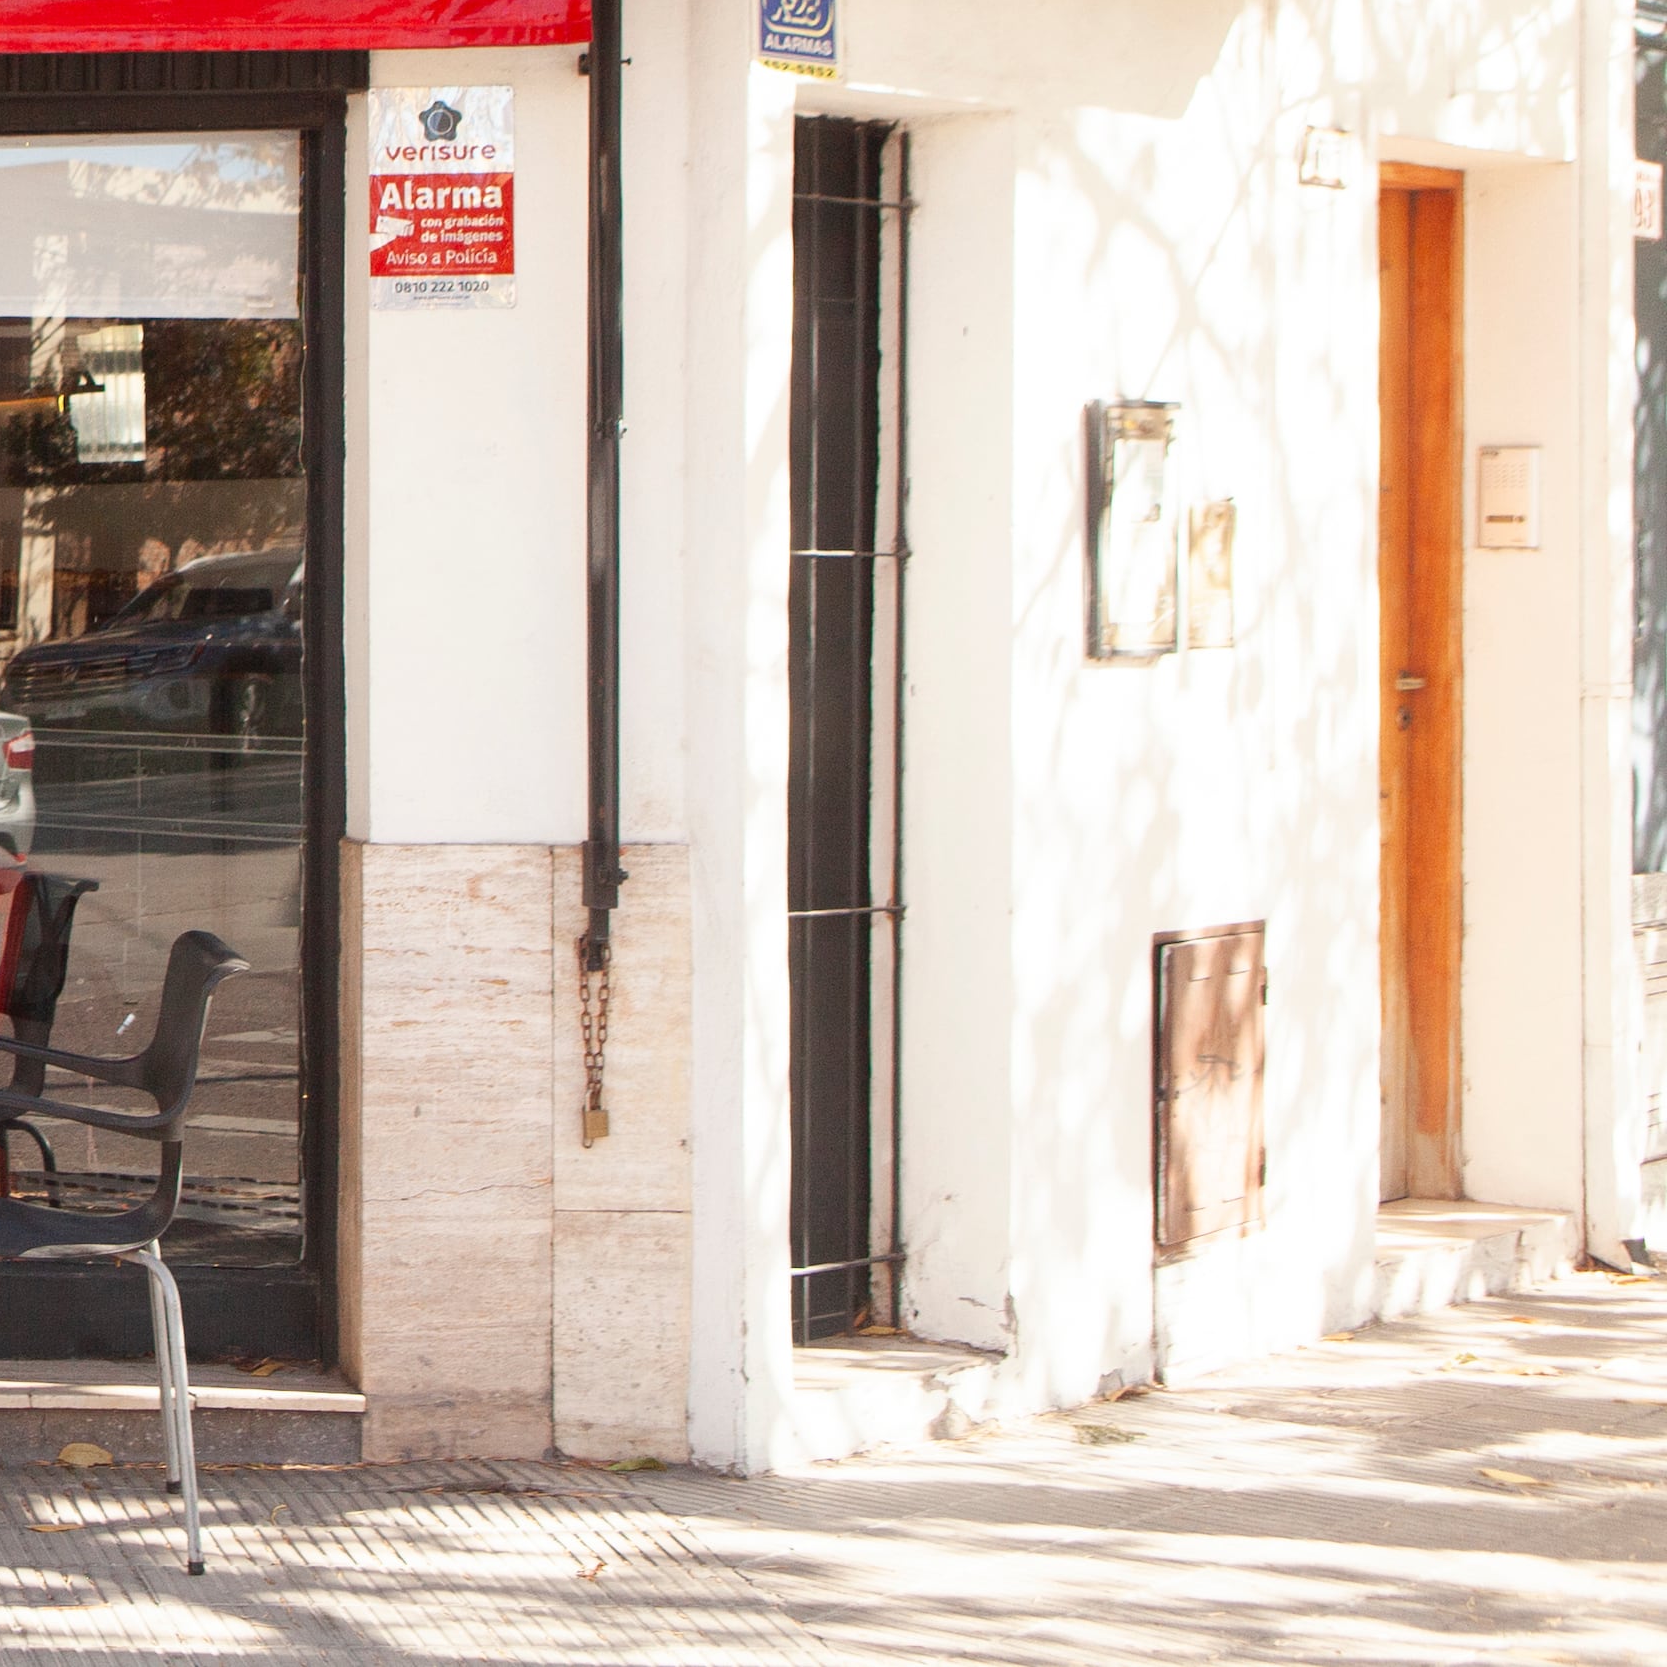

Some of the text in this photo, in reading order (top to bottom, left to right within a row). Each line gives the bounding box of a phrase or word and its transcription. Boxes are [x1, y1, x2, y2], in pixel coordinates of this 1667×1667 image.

[765, 34, 832, 55] ALARMAS
[385, 143, 496, 162] verisure
[379, 180, 503, 211] Alarma
[420, 214, 504, 230] con grabación
[420, 229, 503, 245] de imágenes
[386, 247, 497, 265] Aviso a Policía
[395, 280, 489, 294] 0810 222 1020
